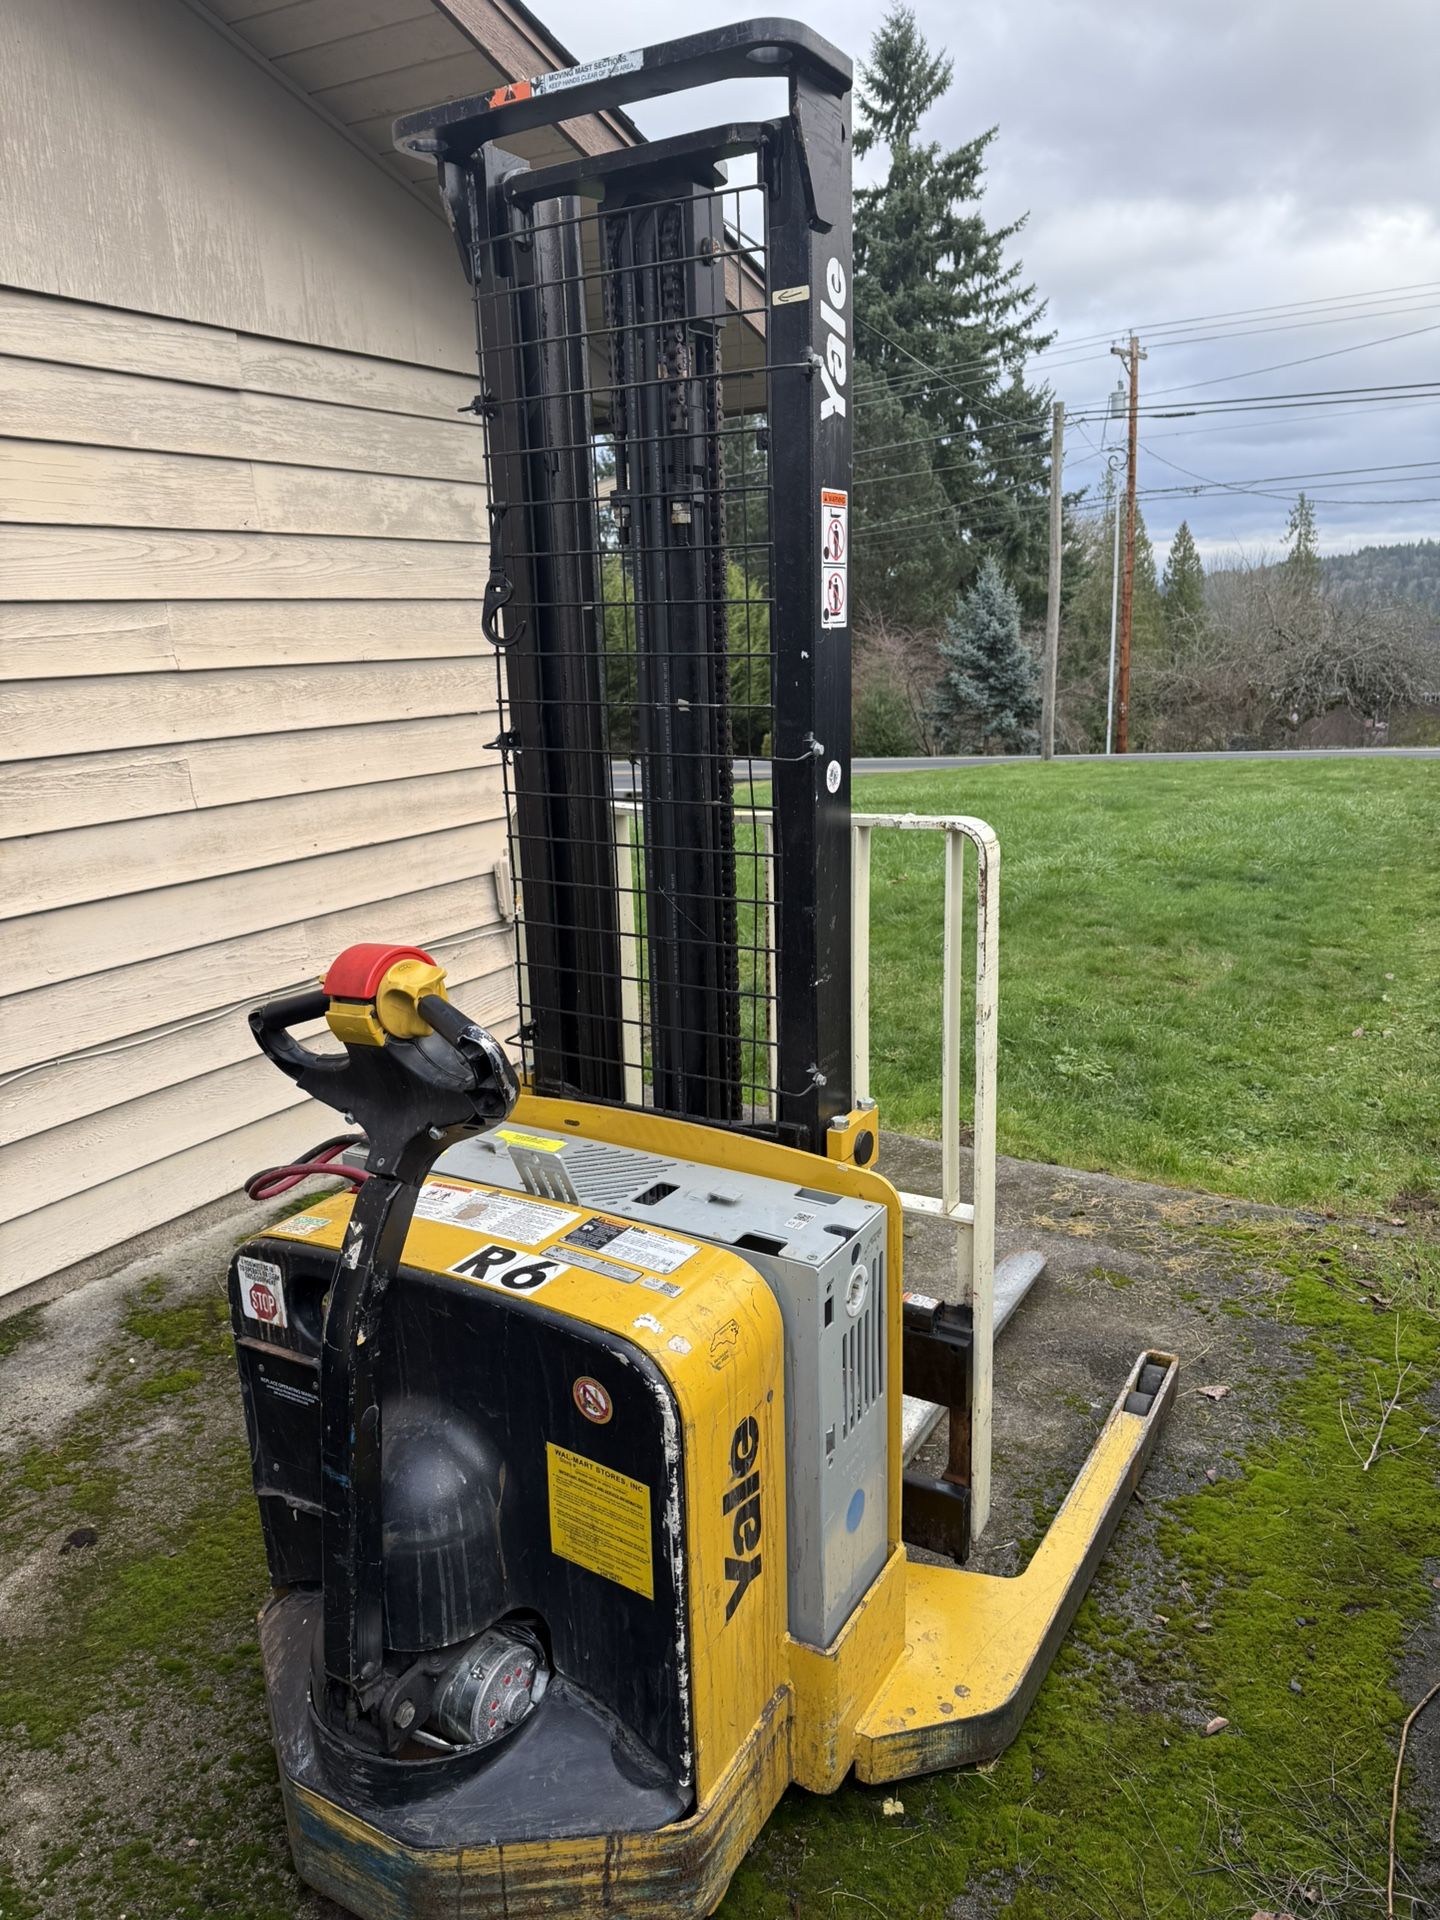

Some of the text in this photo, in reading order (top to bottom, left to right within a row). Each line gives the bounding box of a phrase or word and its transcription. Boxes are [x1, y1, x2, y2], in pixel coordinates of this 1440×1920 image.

[548, 68, 574, 81] MOVING
[575, 62, 593, 75] MAST
[549, 80, 561, 89] KEEP
[562, 75, 580, 85] HANDS
[581, 71, 598, 81] CLEAR
[598, 69, 606, 77] OF
[820, 257, 847, 421] Yale
[452, 1245, 560, 1290] R6
[251, 1290, 275, 1314] STOP
[554, 1448, 593, 1470] WAL-MART
[722, 1415, 762, 1625] Yale
